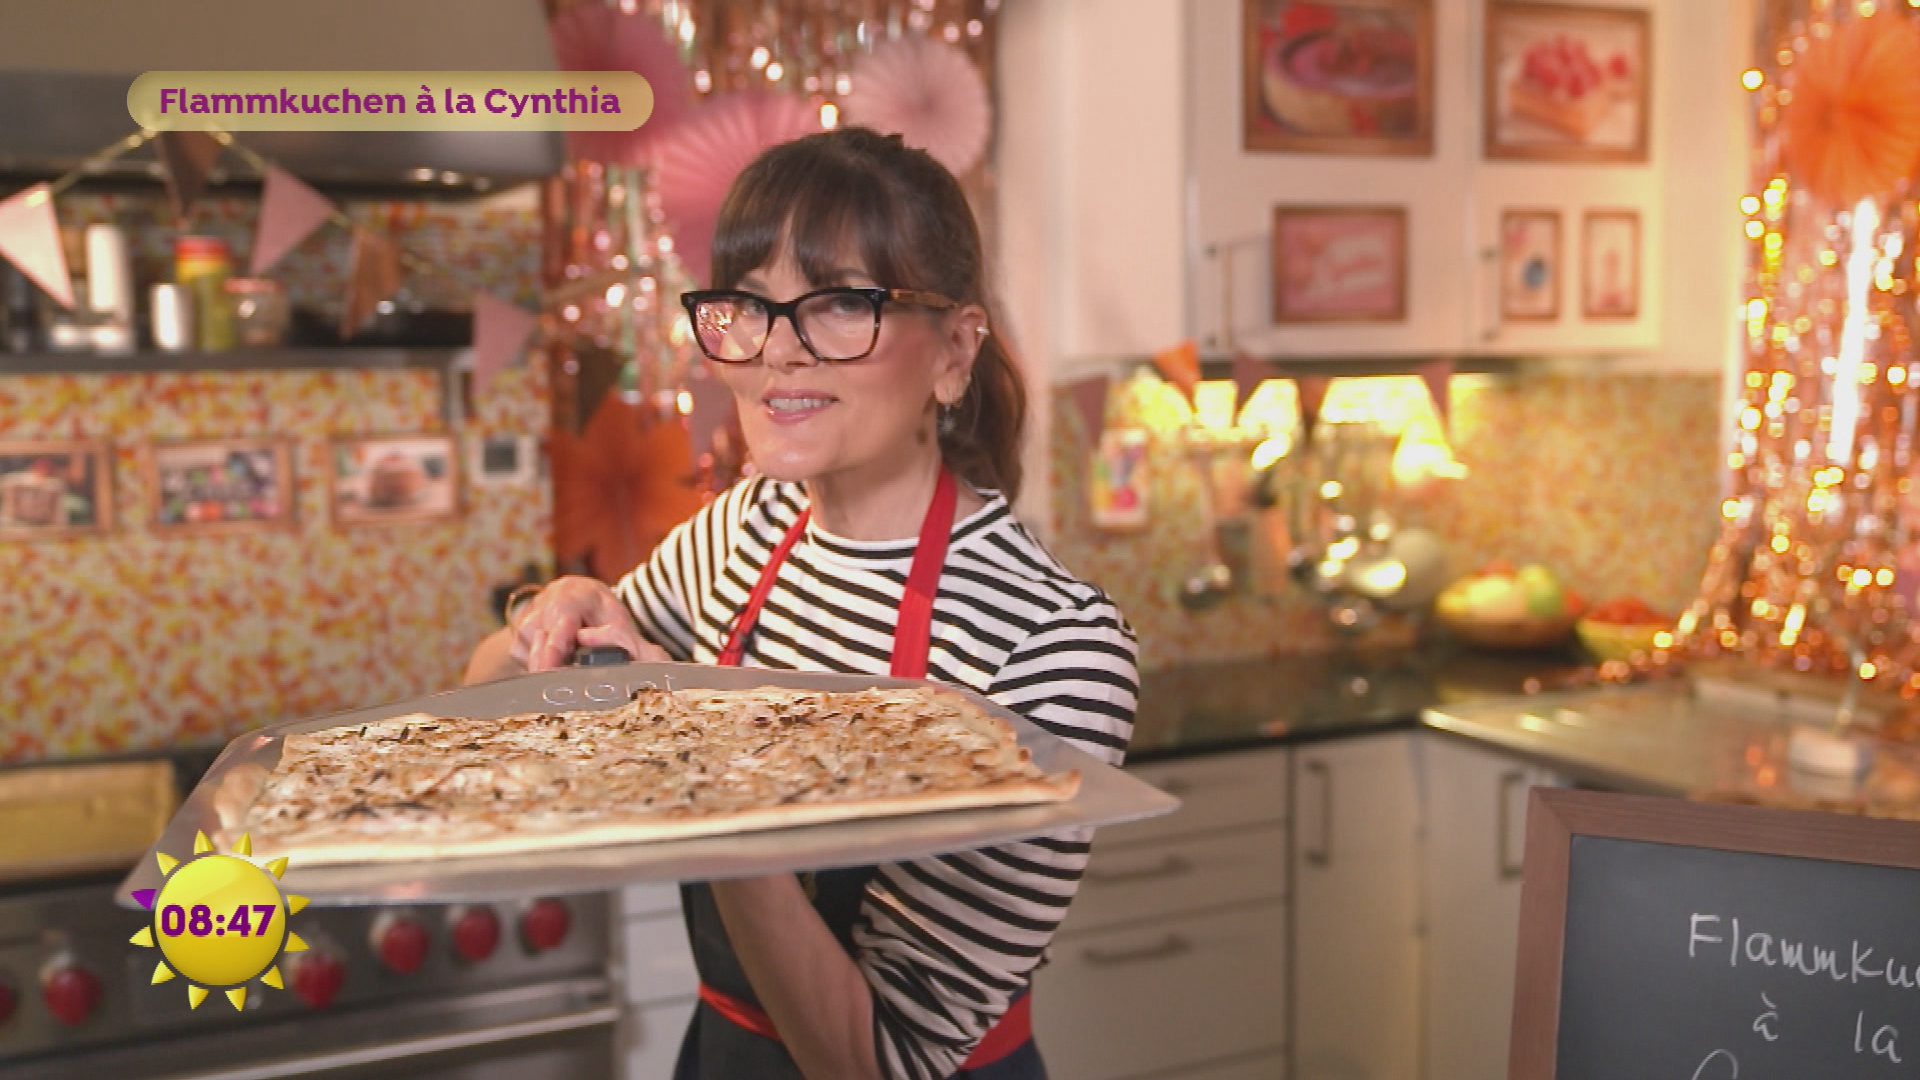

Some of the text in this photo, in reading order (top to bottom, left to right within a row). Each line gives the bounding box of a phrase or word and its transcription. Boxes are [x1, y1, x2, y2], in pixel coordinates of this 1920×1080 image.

[1689, 913, 1920, 989] Flammku
[1752, 991, 1902, 1063] à la
